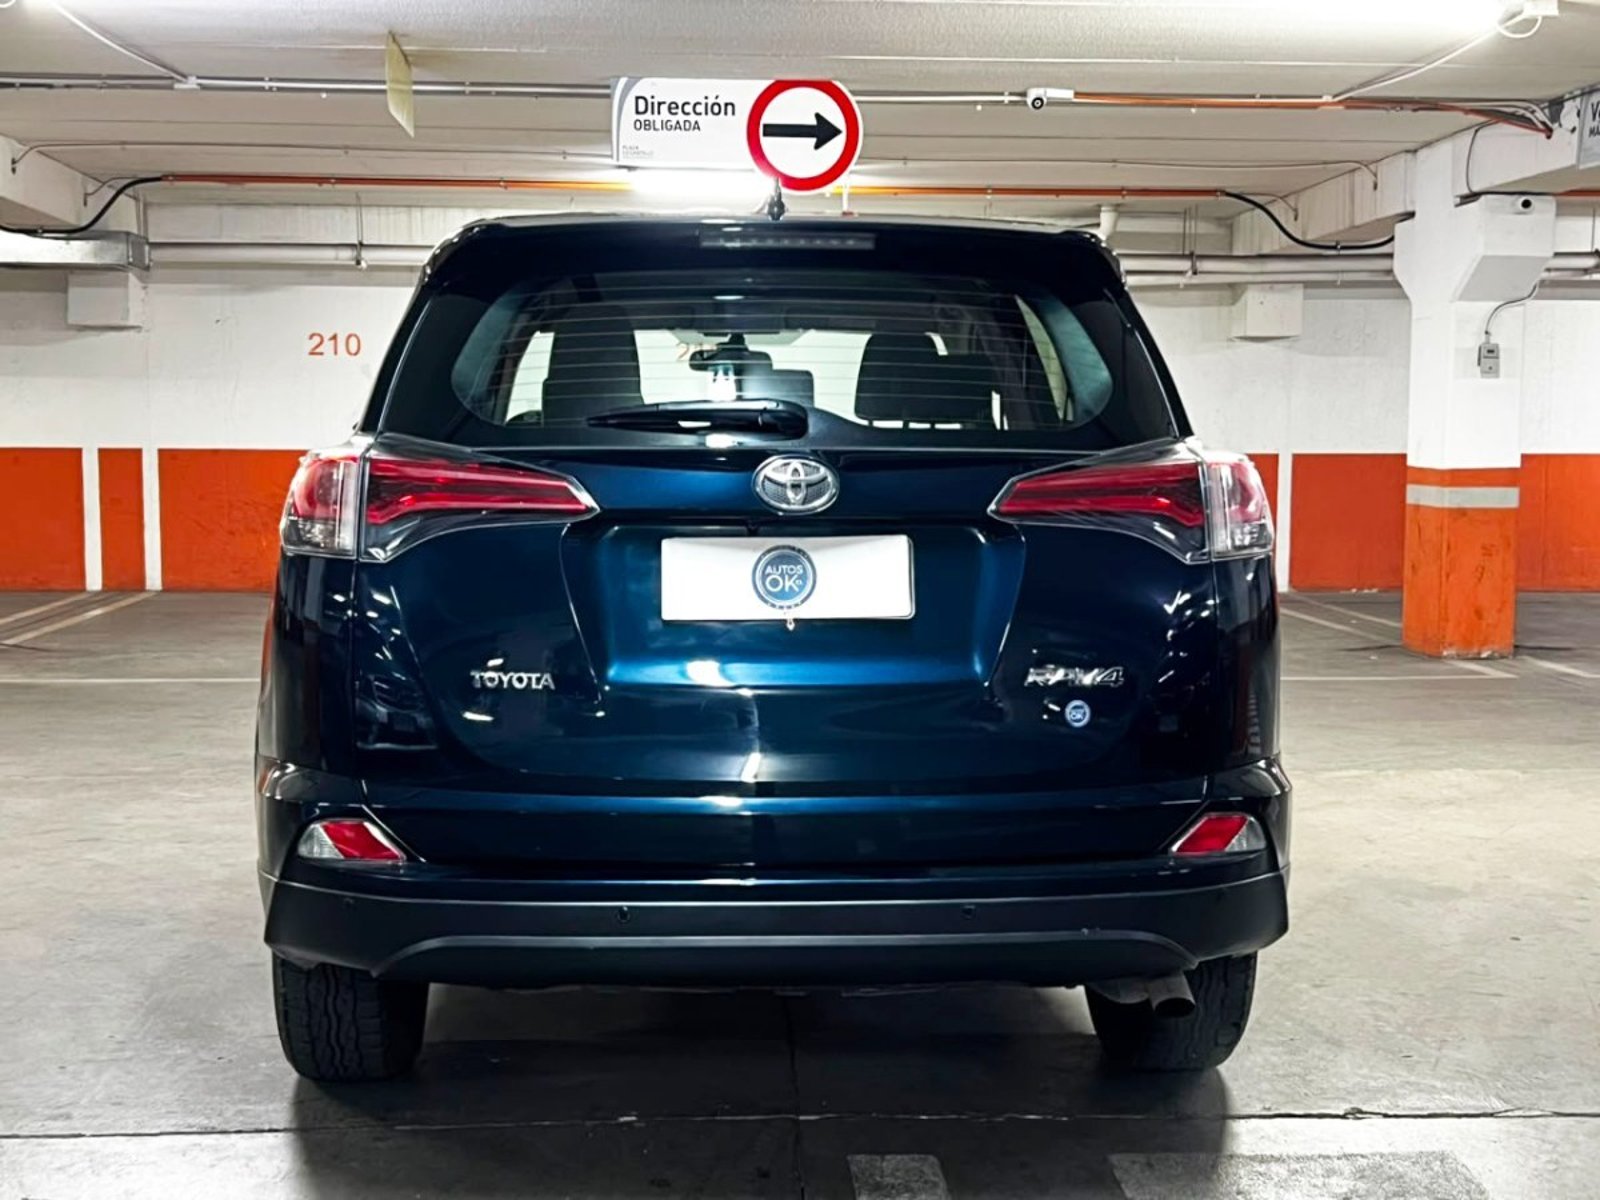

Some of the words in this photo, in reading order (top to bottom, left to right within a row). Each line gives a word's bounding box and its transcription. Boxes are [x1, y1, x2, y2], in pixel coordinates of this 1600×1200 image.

[634, 95, 736, 116] Dirección
[1591, 101, 1600, 122] V
[633, 119, 701, 132] OBLIGADA
[308, 332, 361, 356] 210
[764, 564, 804, 575] AUTOS
[469, 670, 555, 690] TOYOTA
